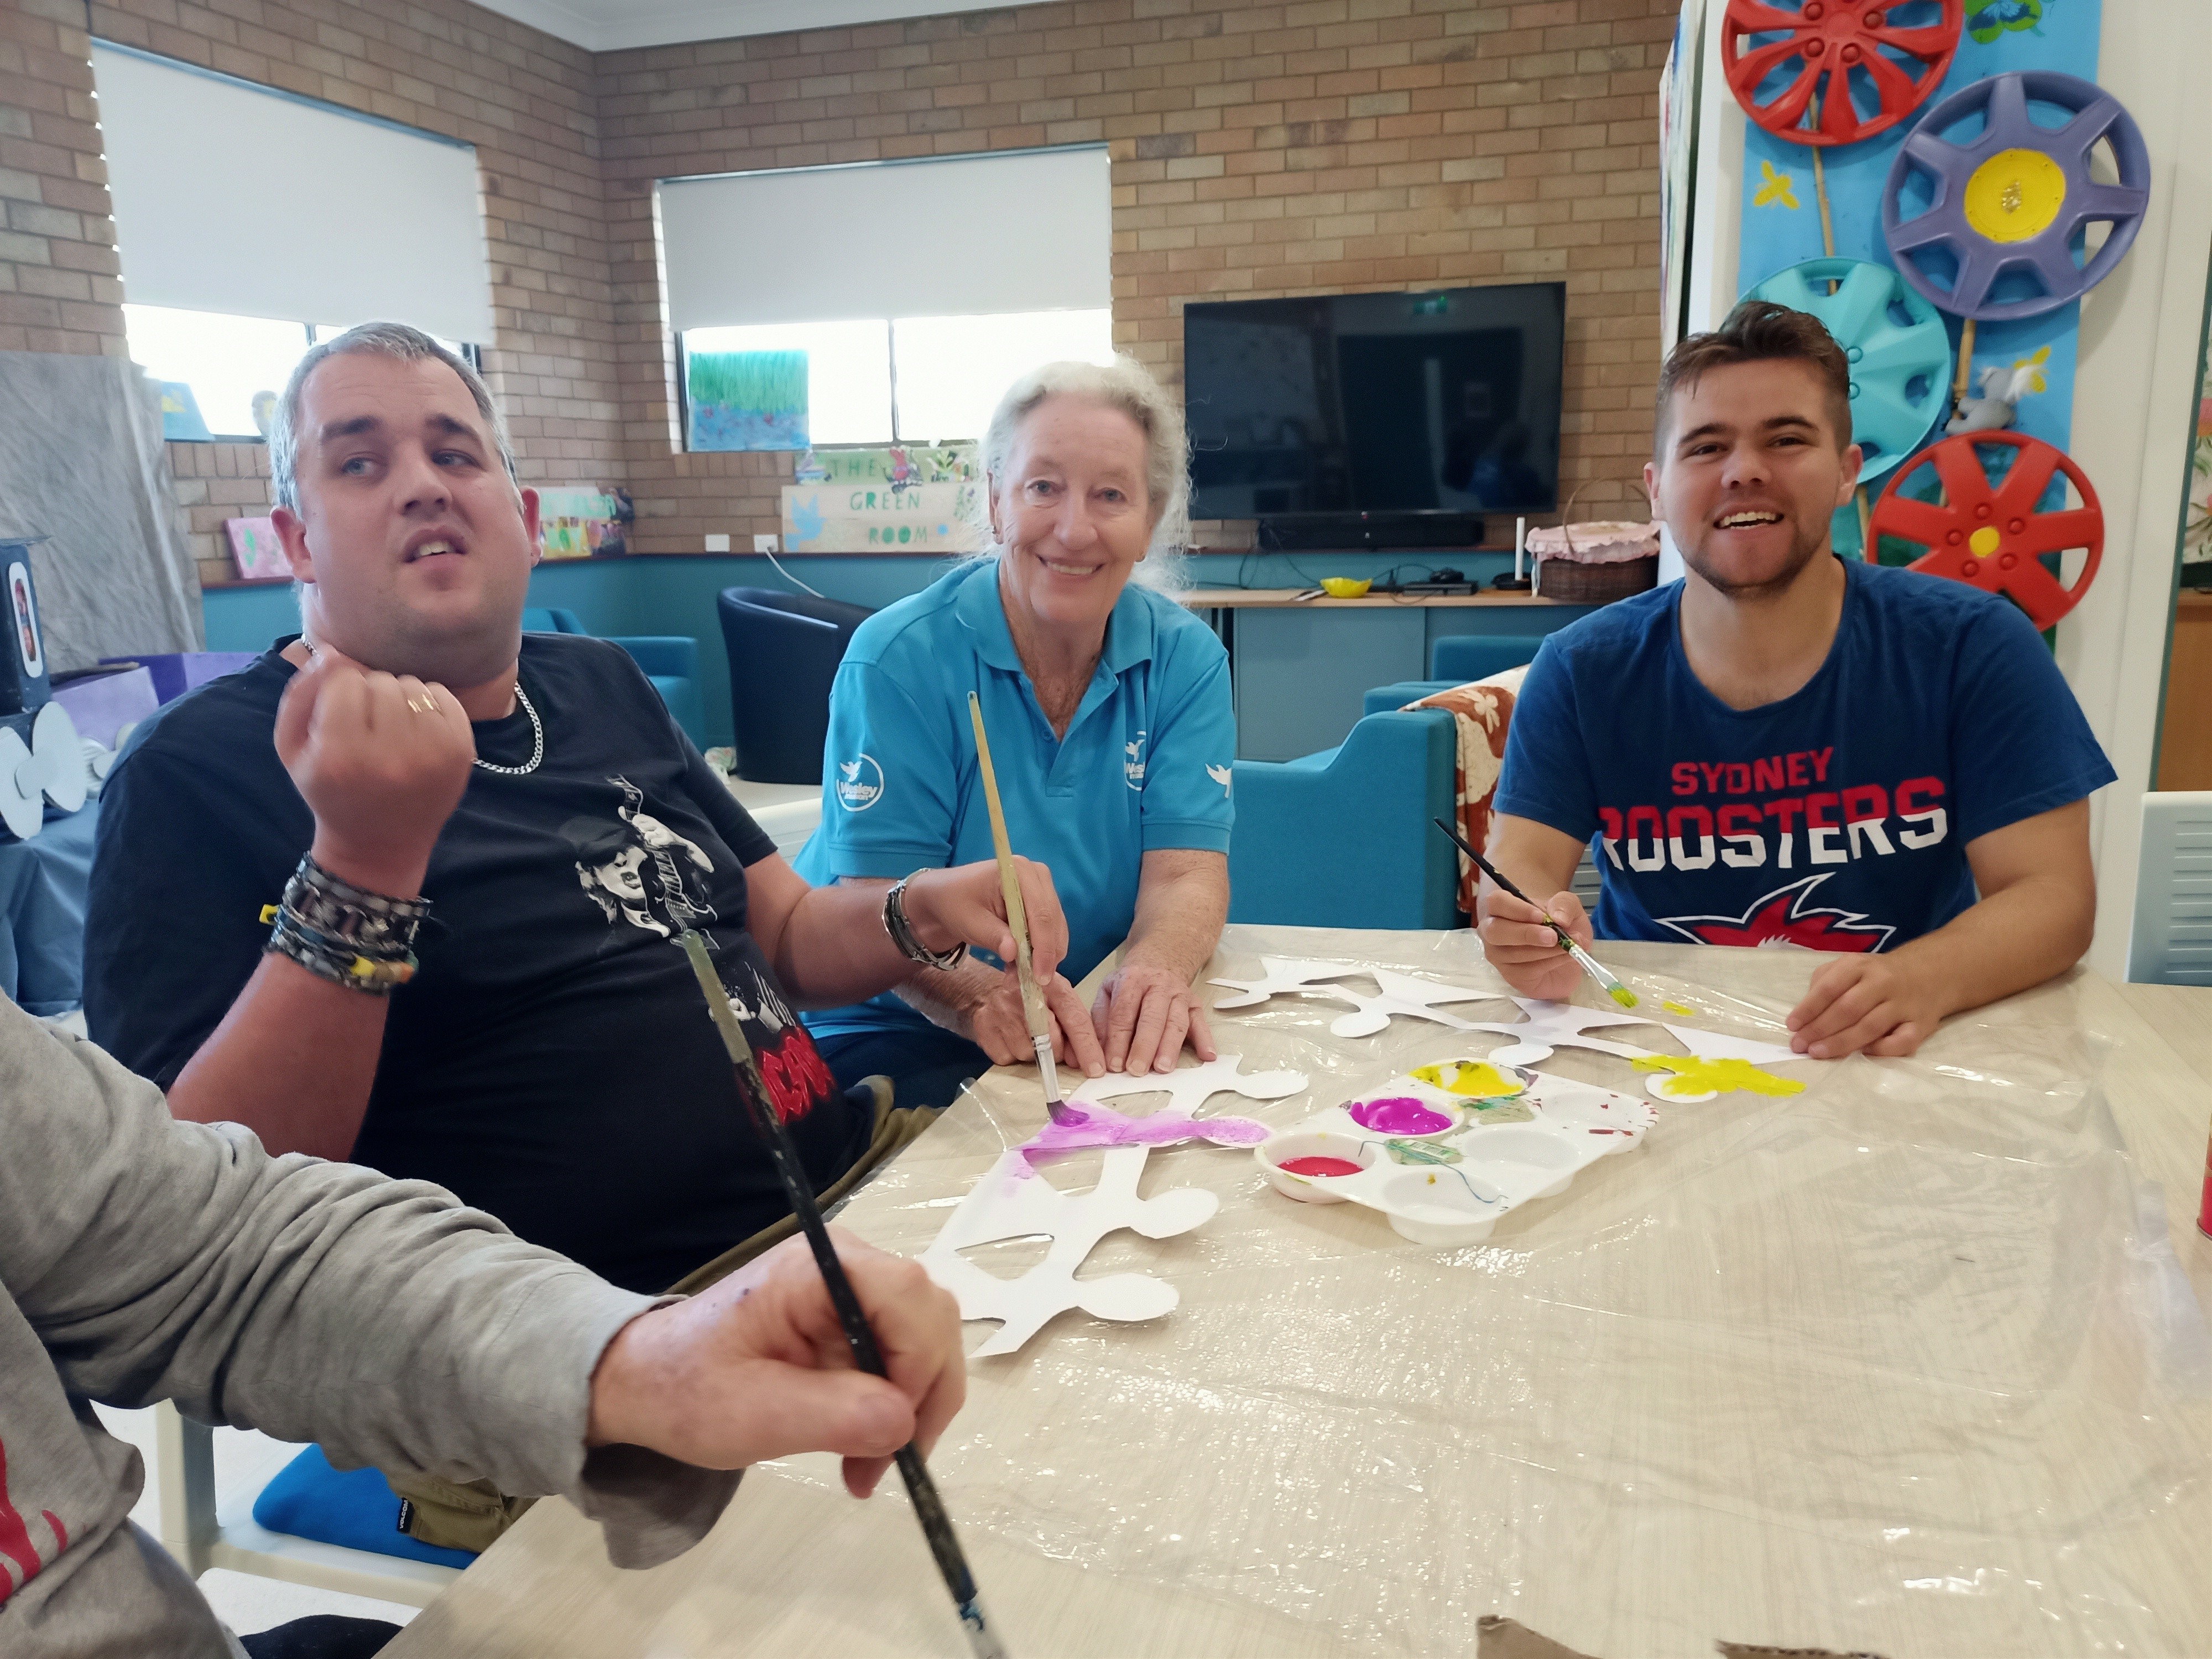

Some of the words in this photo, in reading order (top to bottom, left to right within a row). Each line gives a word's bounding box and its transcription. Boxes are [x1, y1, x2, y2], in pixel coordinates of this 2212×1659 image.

[830, 458, 878, 477] THE
[850, 491, 920, 511] GREEN
[869, 526, 928, 545] ROOM
[1671, 747, 1834, 796] SYDNEY
[399, 1499, 409, 1529] VOLCOM
